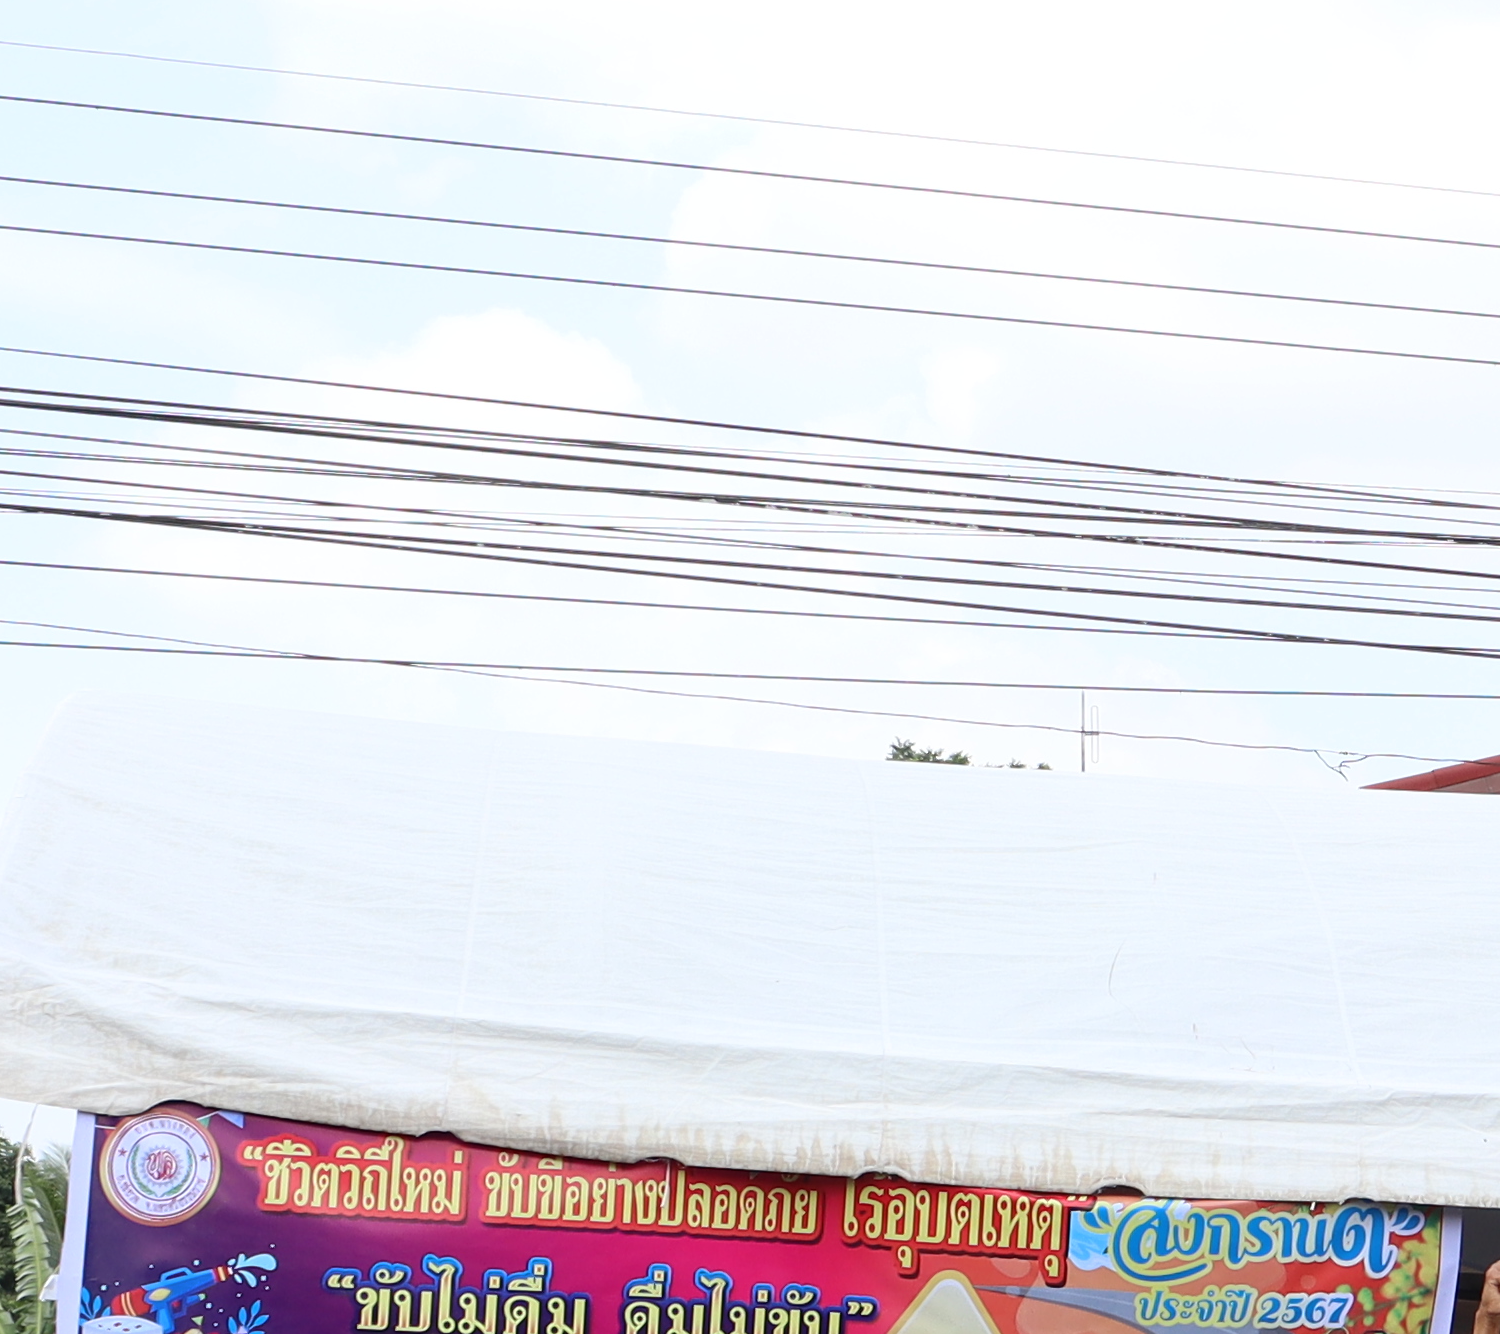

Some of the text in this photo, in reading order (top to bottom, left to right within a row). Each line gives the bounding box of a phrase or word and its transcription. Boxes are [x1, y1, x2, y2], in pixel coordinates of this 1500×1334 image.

[1138, 1288, 1349, 1324] ประจำปี 2567
